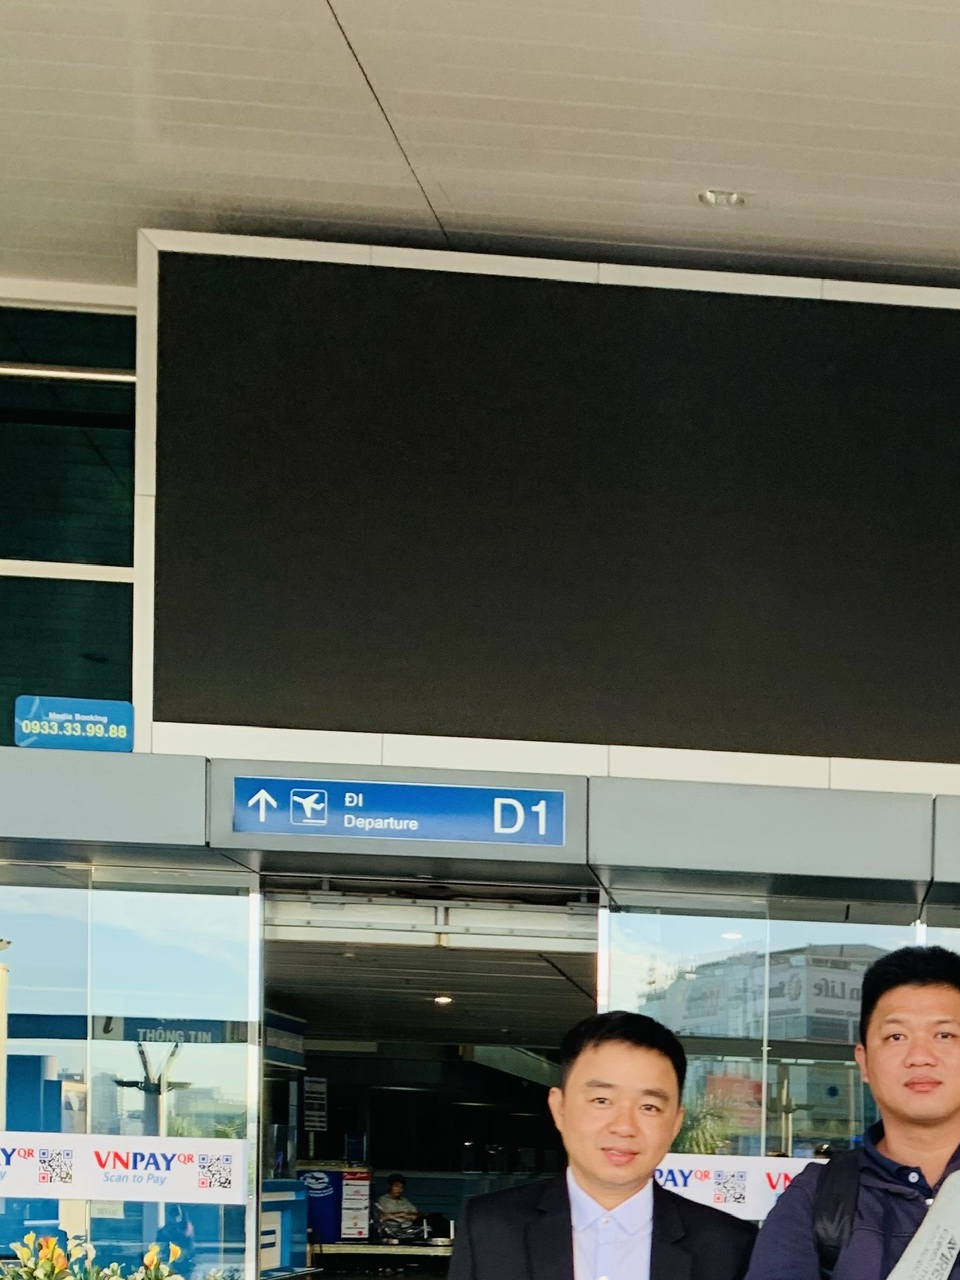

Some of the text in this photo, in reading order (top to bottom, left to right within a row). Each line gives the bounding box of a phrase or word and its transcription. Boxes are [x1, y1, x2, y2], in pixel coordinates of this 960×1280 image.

[22, 720, 127, 738] 0933.33.99.88
[344, 814, 418, 831] Departure
[493, 797, 547, 835] D1
[103, 1171, 166, 1186] Scan to Pay
